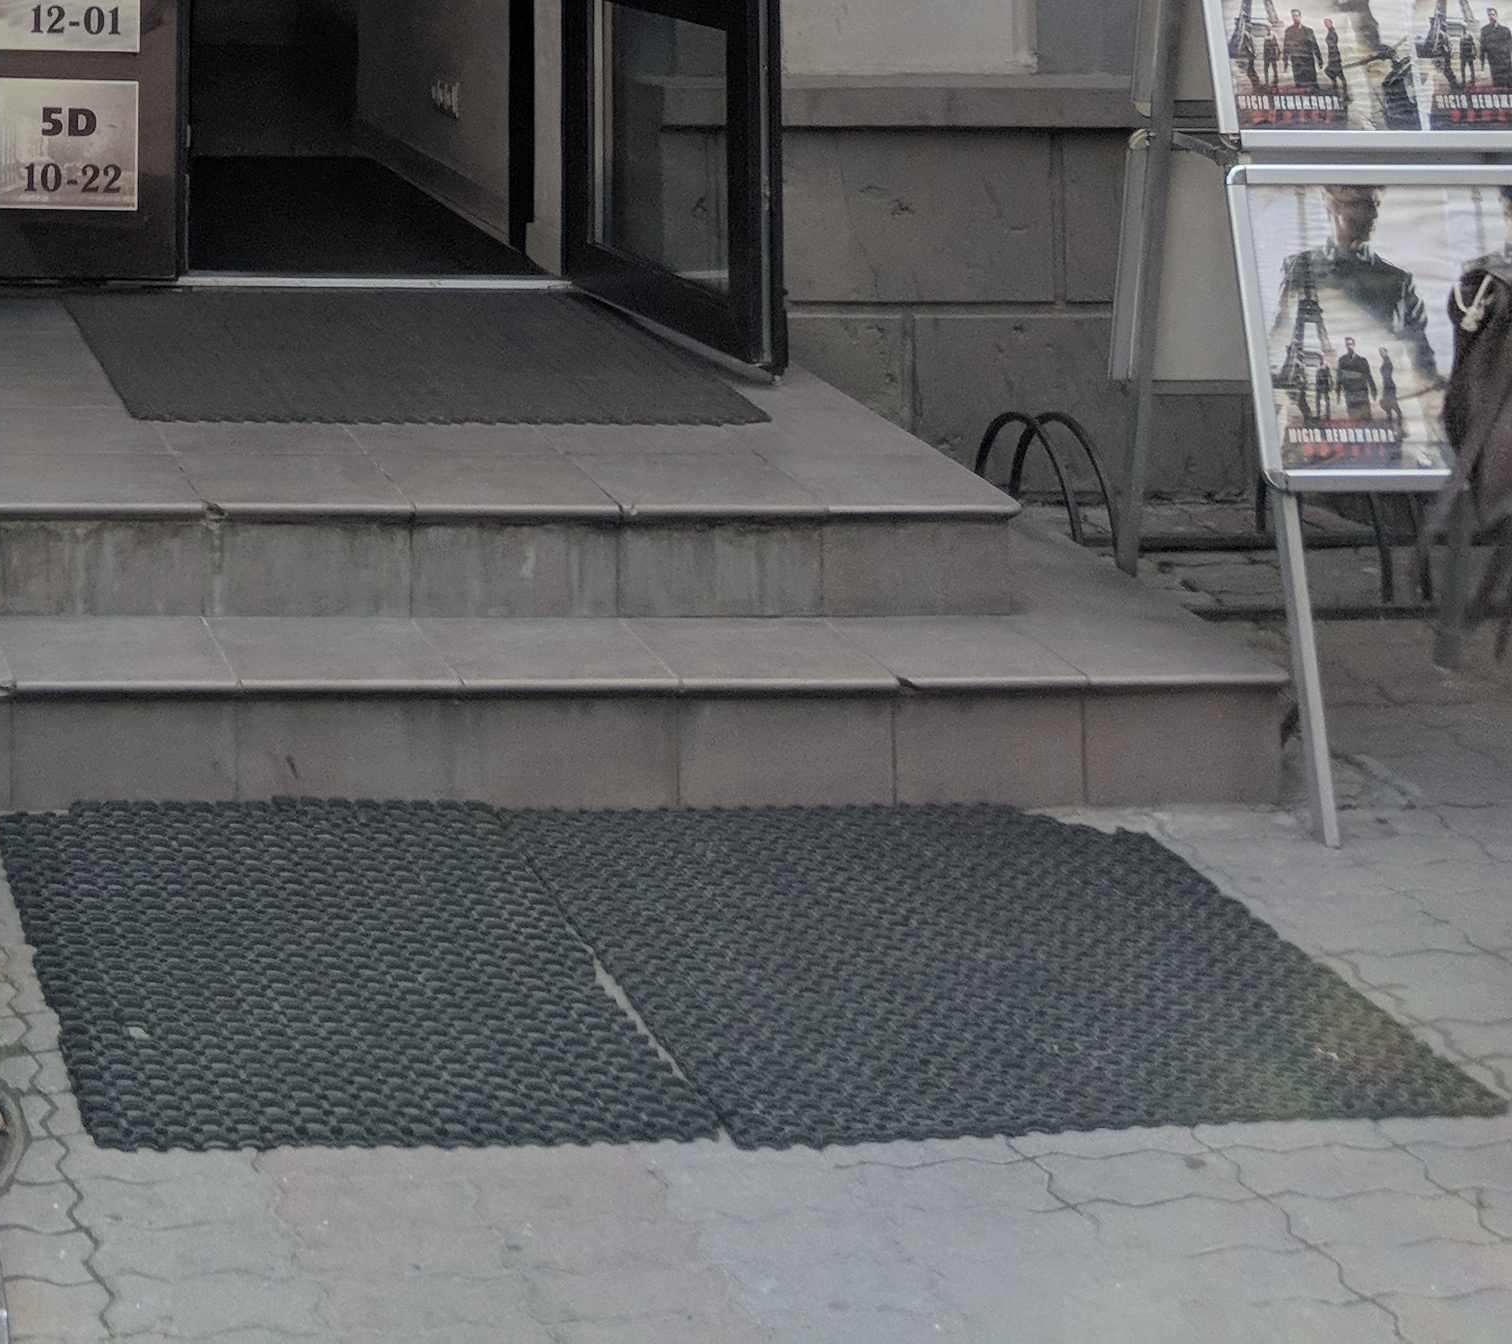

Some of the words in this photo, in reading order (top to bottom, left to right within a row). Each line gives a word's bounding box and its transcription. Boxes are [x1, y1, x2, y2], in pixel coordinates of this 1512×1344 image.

[31, 4, 121, 35] 12-01
[41, 107, 97, 137] 5D
[24, 163, 123, 193] 10-22
